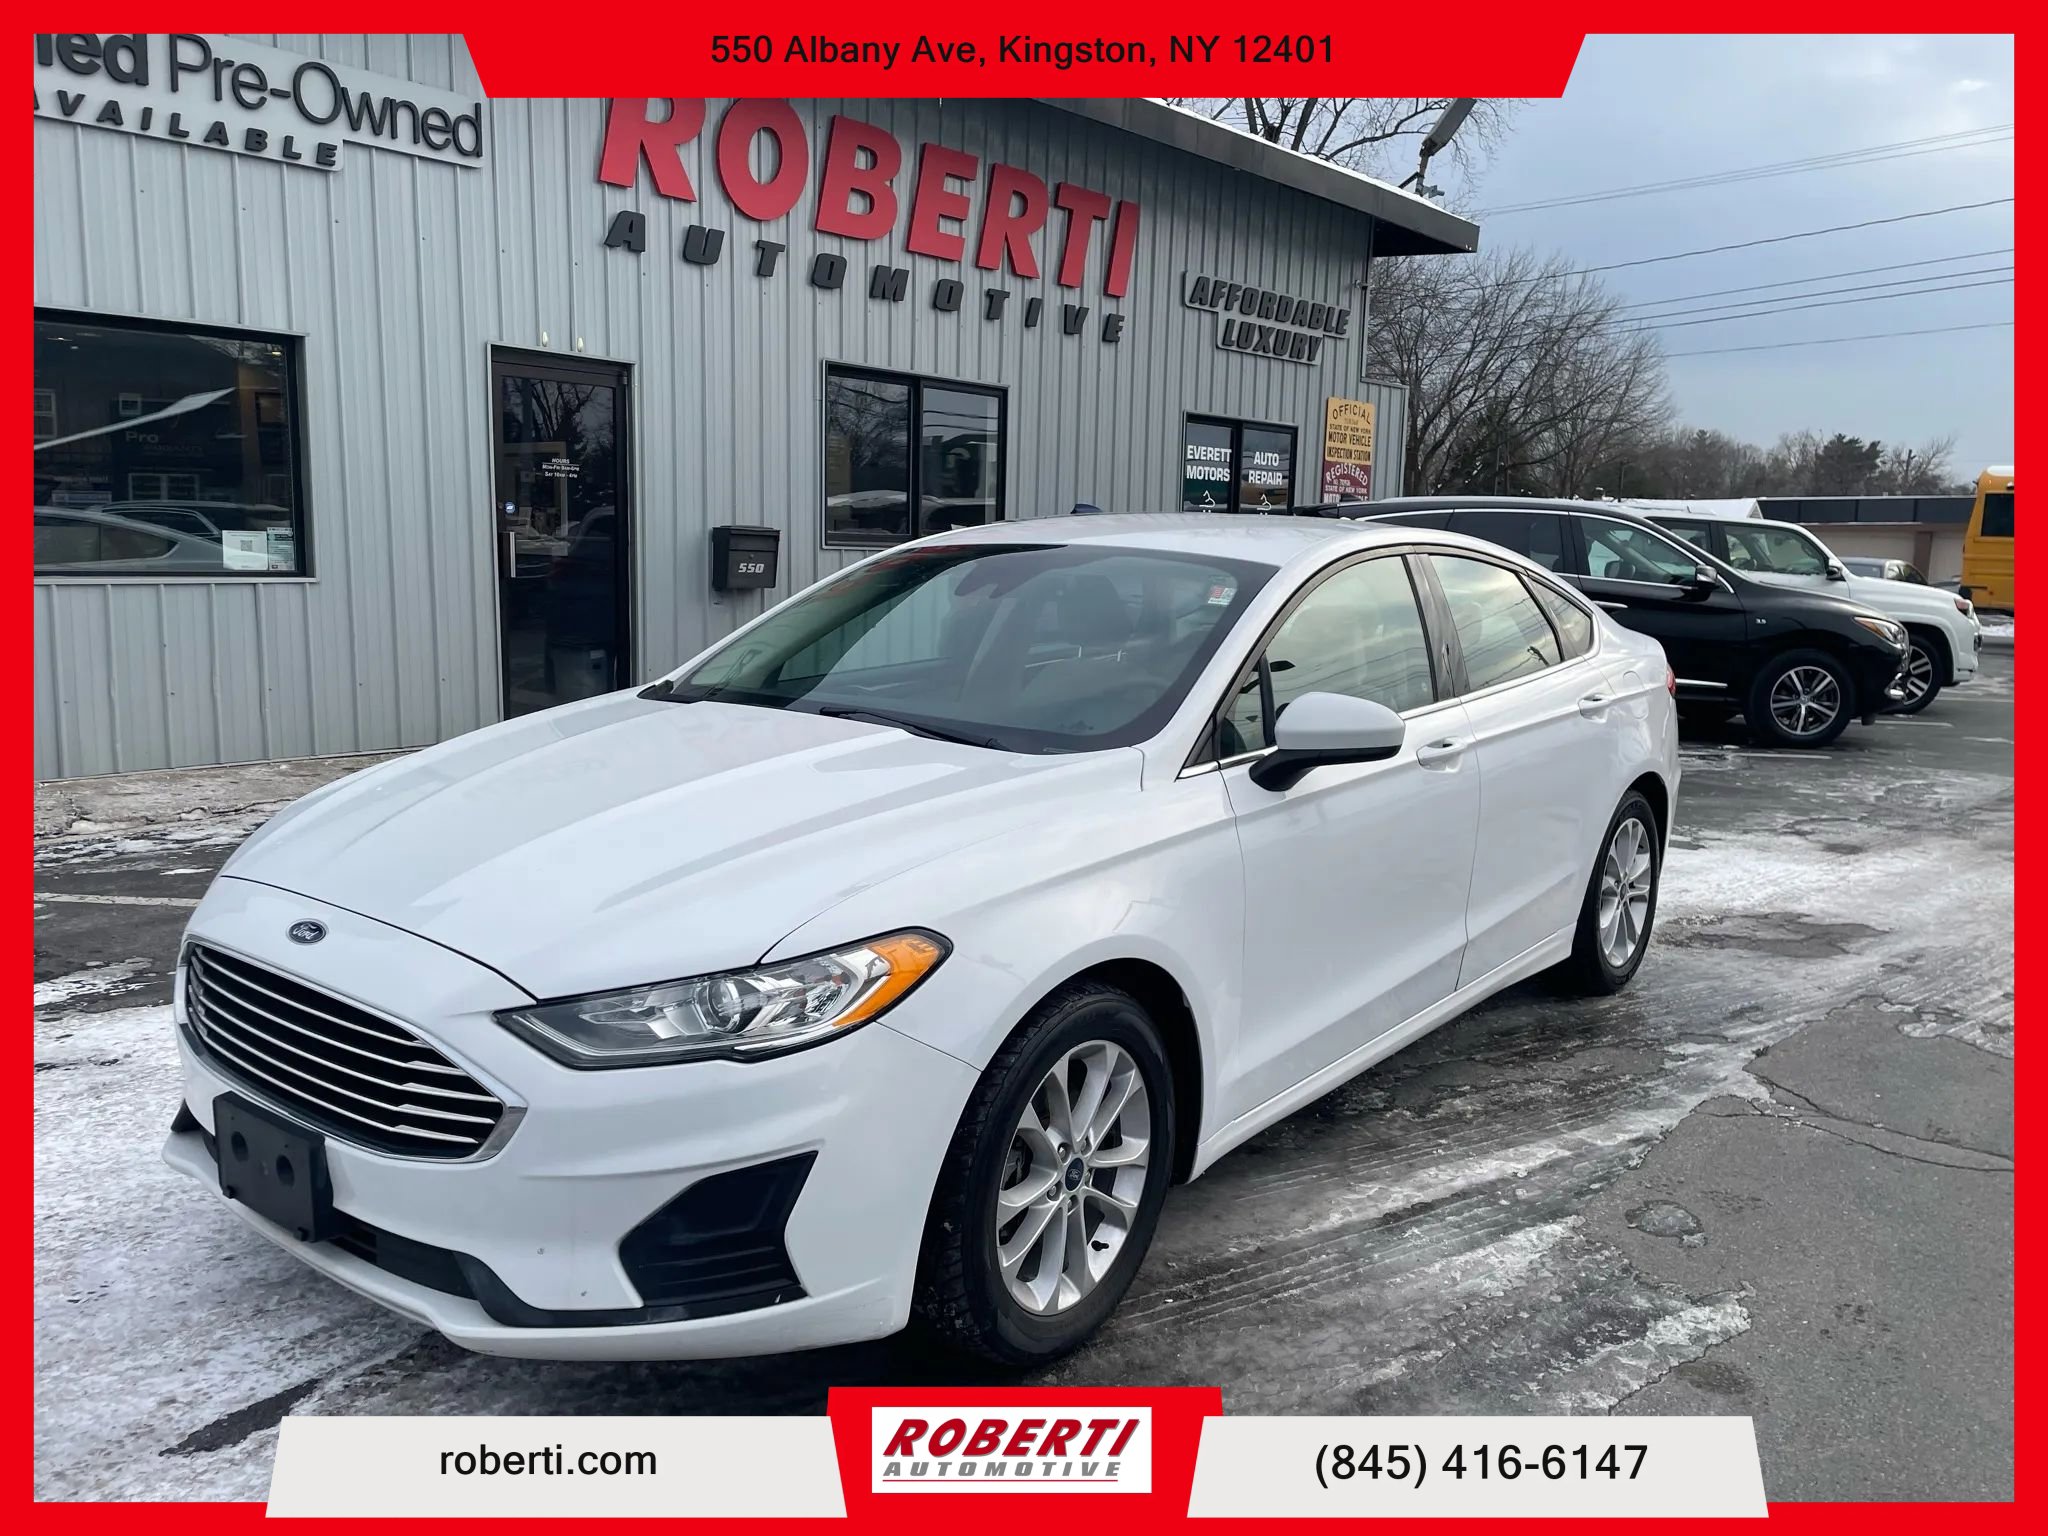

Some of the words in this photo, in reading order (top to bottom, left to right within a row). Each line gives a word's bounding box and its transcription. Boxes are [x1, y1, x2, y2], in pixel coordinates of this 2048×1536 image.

[168, 34, 483, 158] Pre-Owned
[34, 88, 338, 166] VAILABLE
[599, 98, 1138, 298] ROBERTI
[604, 210, 1125, 343] AUTOMOTIVE
[1189, 275, 1351, 334] AFFORDABLE
[1222, 318, 1323, 361] LUXURY
[1332, 403, 1371, 425] OFFICIAL
[1329, 423, 1342, 431] STATE
[1328, 431, 1348, 444] MOTOR
[1349, 433, 1372, 447] VEHICLE
[1186, 444, 1232, 463] EVERETT
[1253, 451, 1280, 467] AUTO
[1327, 446, 1353, 459] INSPECTION
[1353, 449, 1371, 461] STATION
[1186, 464, 1231, 482] MOTORS
[1248, 470, 1283, 486] REPAIR
[1325, 462, 1368, 486] REGISTERED
[1325, 484, 1338, 492] STATE
[738, 562, 765, 574] 550
